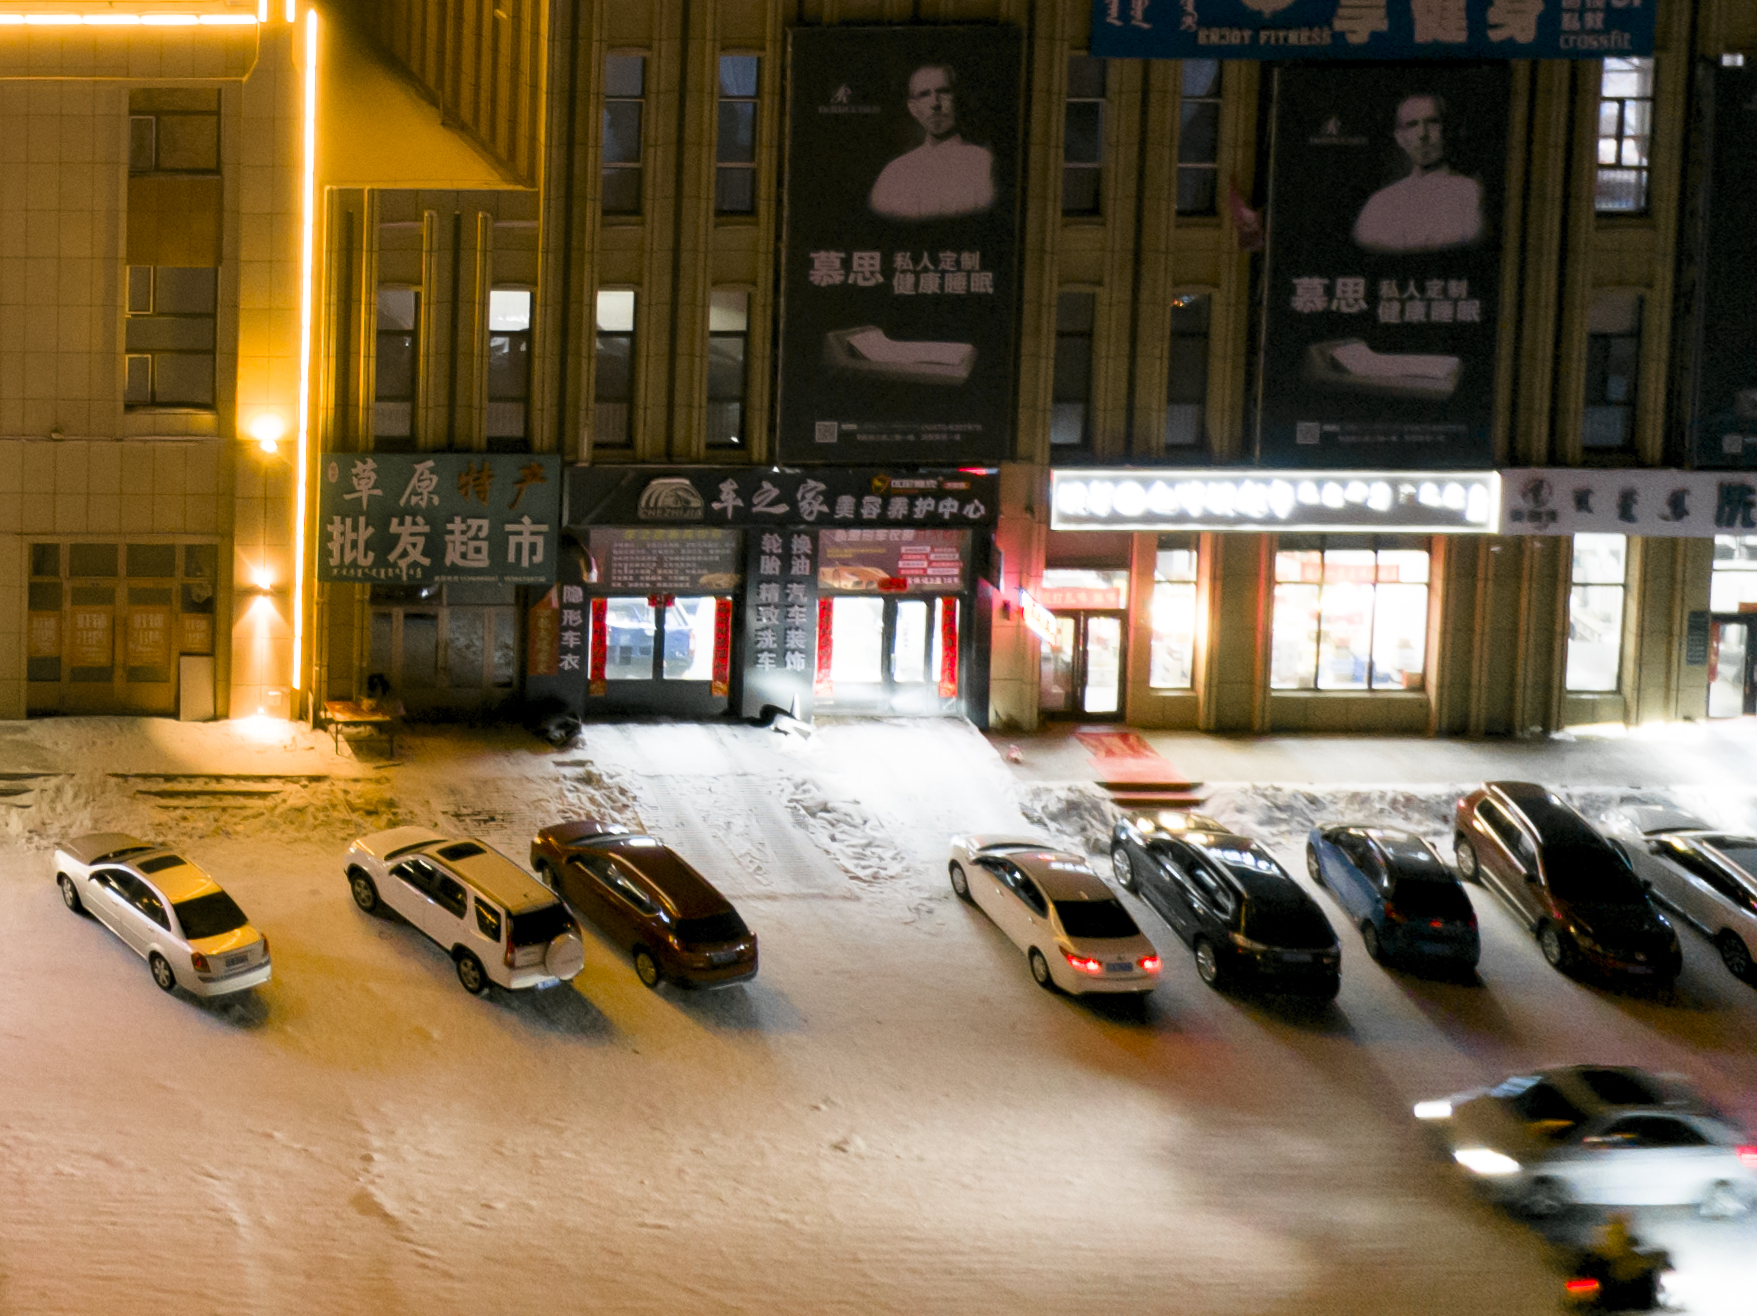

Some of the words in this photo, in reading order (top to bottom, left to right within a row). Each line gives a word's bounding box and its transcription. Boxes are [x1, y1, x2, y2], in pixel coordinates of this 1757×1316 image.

[808, 250, 884, 287] 慕思
[892, 250, 981, 271] 私人定制
[892, 271, 994, 295] 健康睡眠
[1291, 276, 1369, 314] 慕思
[343, 457, 547, 511] 草原特产
[711, 477, 831, 522] 车之家
[834, 495, 987, 520] 美容养护中心
[326, 515, 550, 569] 批发超市
[760, 533, 783, 575] 轮胎
[790, 533, 813, 575] 换油
[559, 584, 584, 671] 隐形车衣
[755, 581, 781, 672] 精致洗车
[784, 582, 808, 672] 汽车装饰
